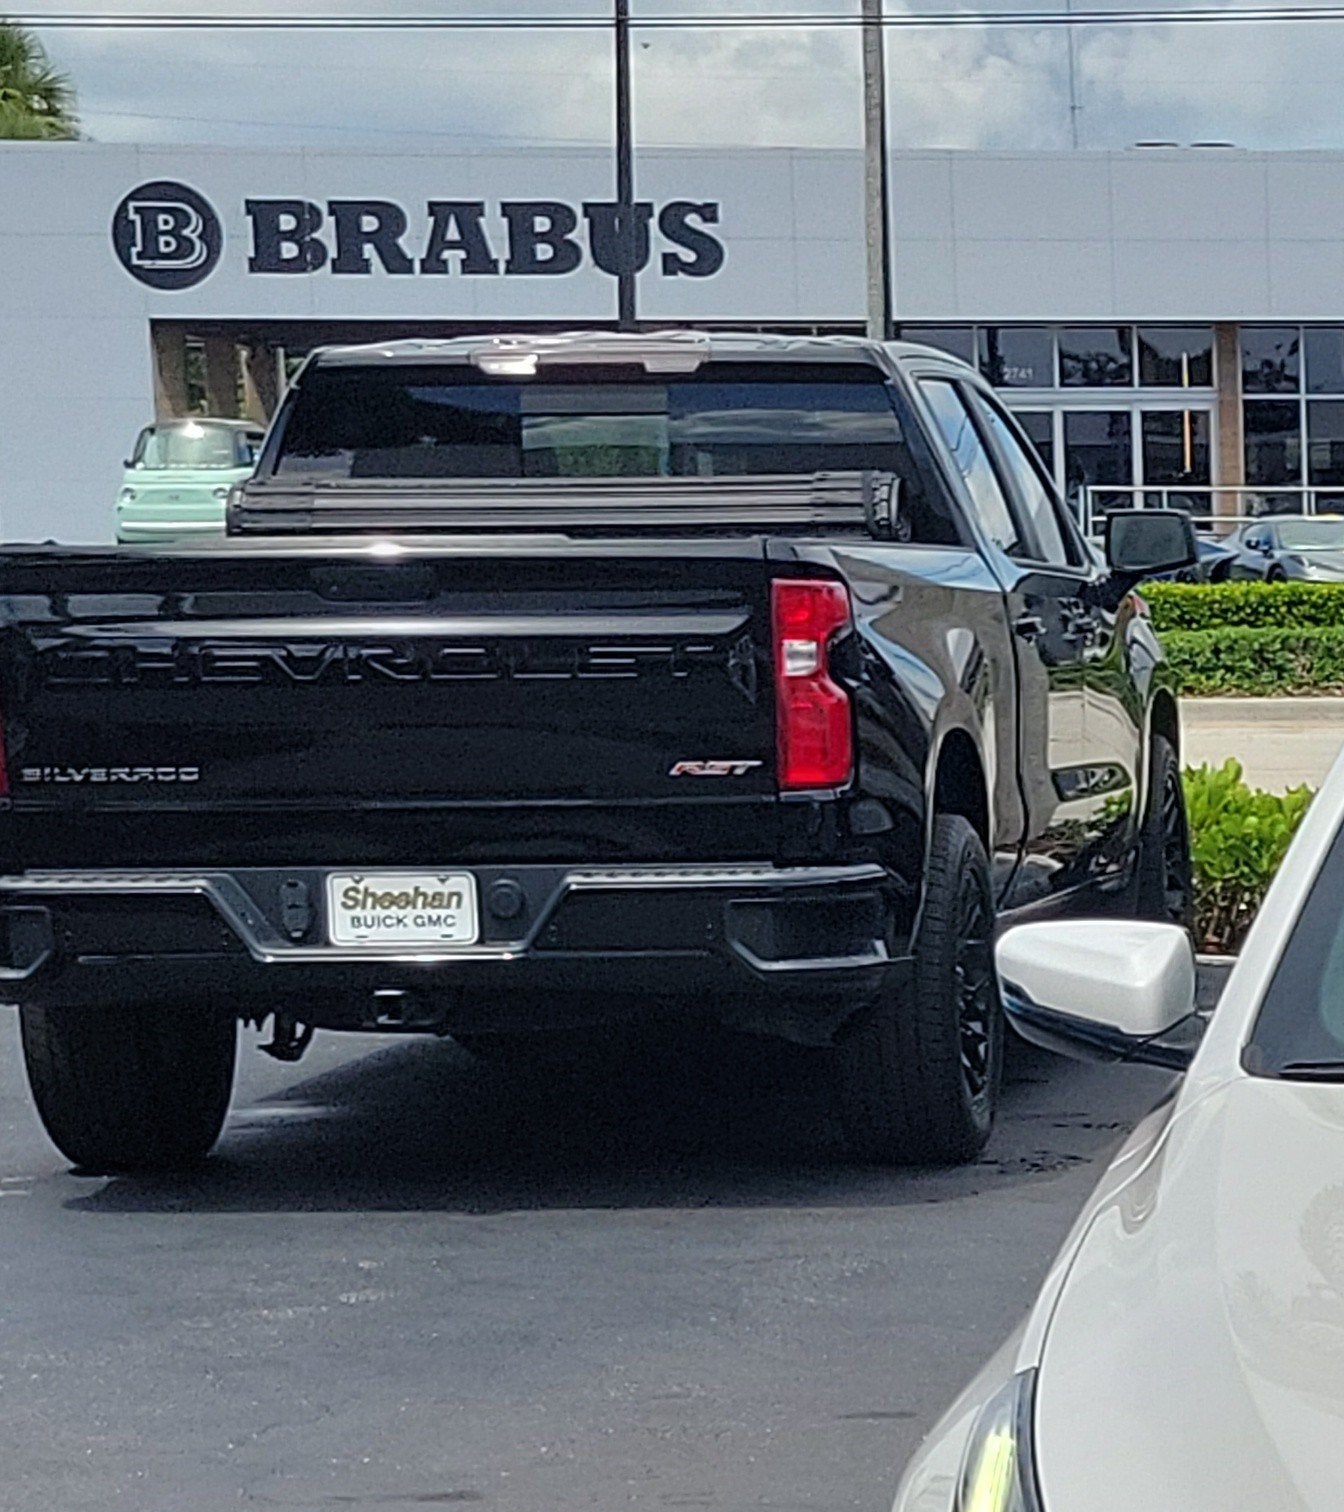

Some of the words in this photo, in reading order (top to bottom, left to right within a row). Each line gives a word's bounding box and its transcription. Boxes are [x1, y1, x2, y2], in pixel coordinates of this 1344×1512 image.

[244, 199, 726, 277] BRABUS
[48, 645, 716, 683] CHEVROLET
[21, 766, 199, 782] SILVERADO
[669, 759, 763, 776] RST
[340, 885, 463, 910] Sheehan
[351, 914, 408, 930] BUICK
[413, 914, 457, 929] GMC
